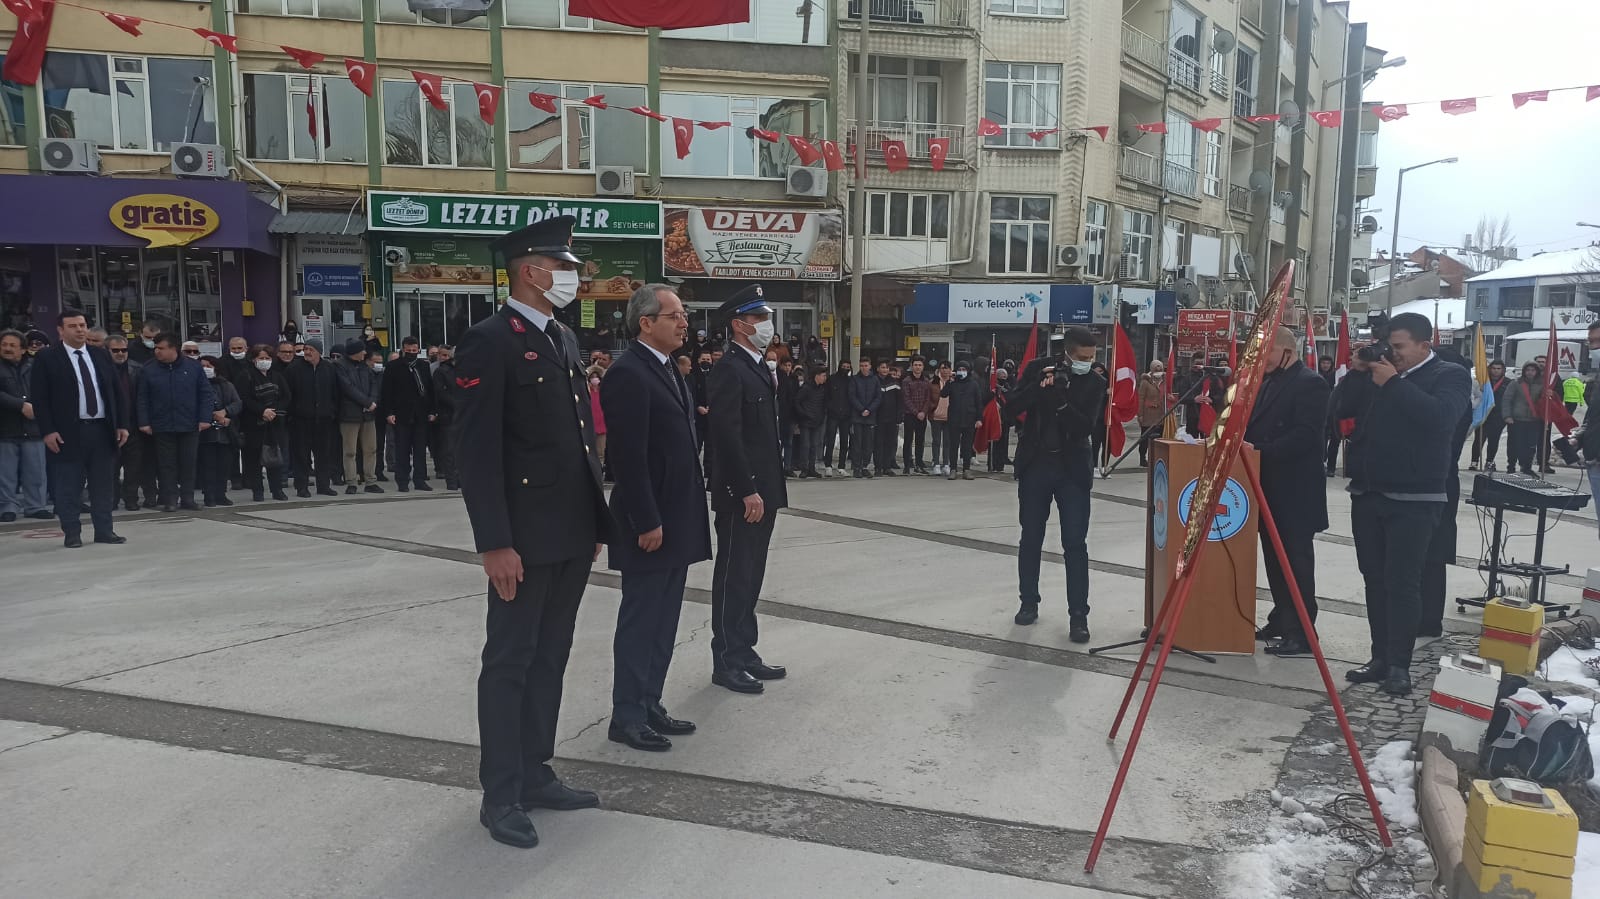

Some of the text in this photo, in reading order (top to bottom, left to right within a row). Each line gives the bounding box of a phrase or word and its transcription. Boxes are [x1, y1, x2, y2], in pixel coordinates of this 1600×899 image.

[121, 201, 207, 229] gratis
[386, 207, 405, 215] LEZZET
[441, 202, 520, 225] LEZZET
[712, 211, 796, 231] DEVA
[728, 241, 780, 252] Restaurant
[741, 268, 762, 277] YEMEK
[962, 299, 1026, 309] Türk Telekom
